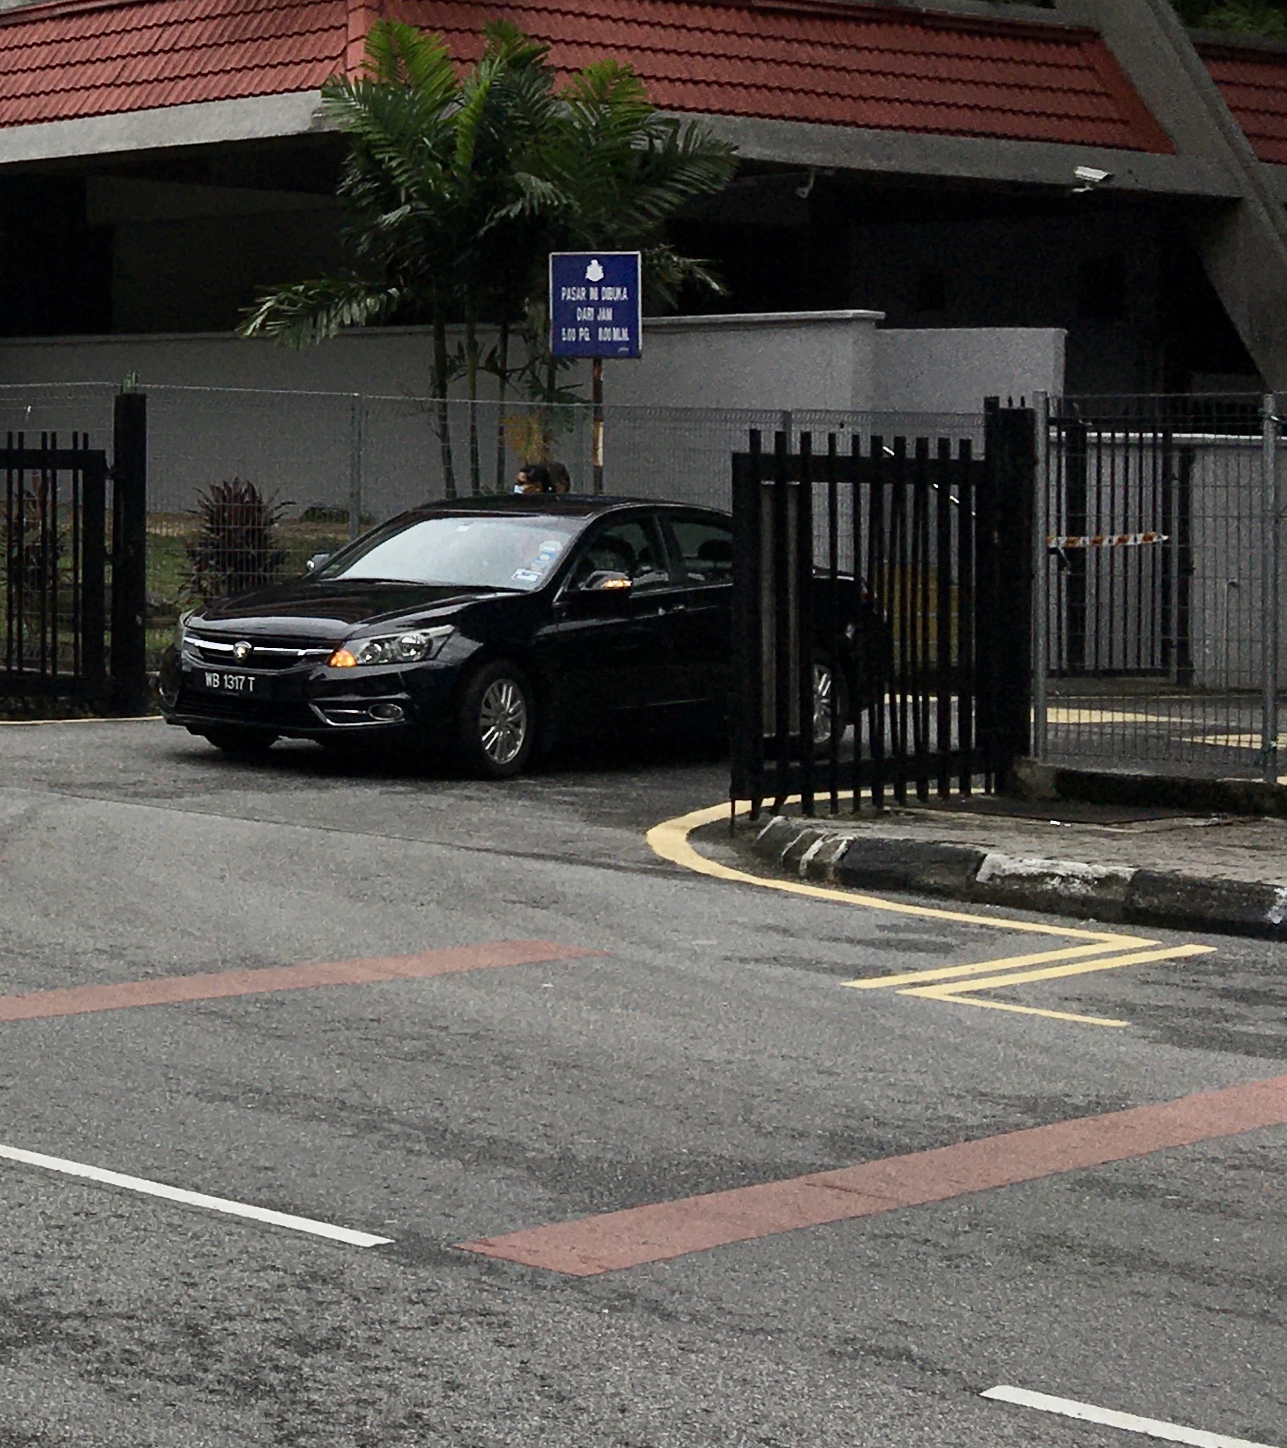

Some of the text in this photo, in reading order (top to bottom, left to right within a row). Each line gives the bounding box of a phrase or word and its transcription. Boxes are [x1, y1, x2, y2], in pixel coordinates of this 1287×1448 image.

[561, 287, 586, 301] PASAR
[601, 287, 628, 301] DIBUKA
[576, 307, 613, 321] DARI JAM
[205, 672, 256, 691] WB 1317 T
